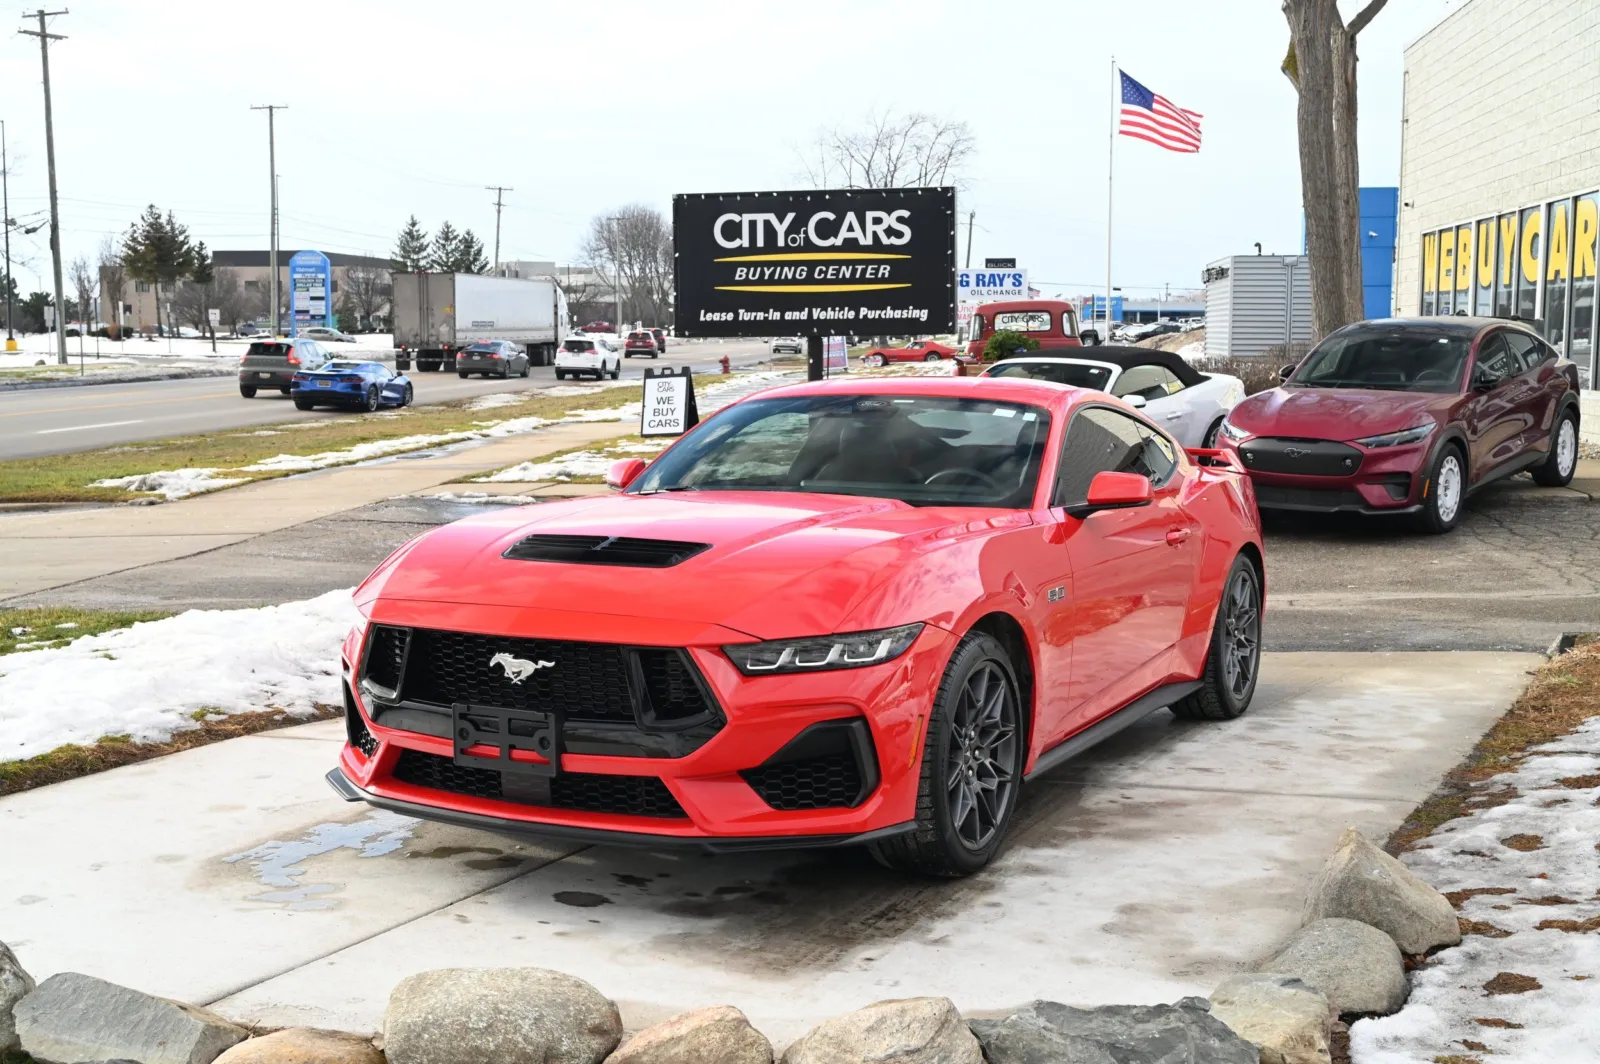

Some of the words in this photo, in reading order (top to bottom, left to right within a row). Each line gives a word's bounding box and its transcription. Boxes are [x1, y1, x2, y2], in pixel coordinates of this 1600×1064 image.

[713, 212, 796, 249] CITY
[787, 226, 807, 247] of
[807, 209, 912, 247] CARS
[734, 265, 808, 281] BUYING
[814, 264, 891, 279] CENTER
[975, 273, 1023, 288] RAY'S
[699, 308, 734, 322] Lease
[738, 308, 781, 321] Turn-In
[785, 307, 808, 321] and
[812, 307, 856, 320] Vehicle
[859, 306, 929, 322] Purchasing
[1001, 316, 1020, 324] CITY
[1021, 314, 1045, 323] CARS
[656, 396, 674, 405] WE
[653, 408, 676, 416] BUY
[648, 418, 680, 429] CARS
